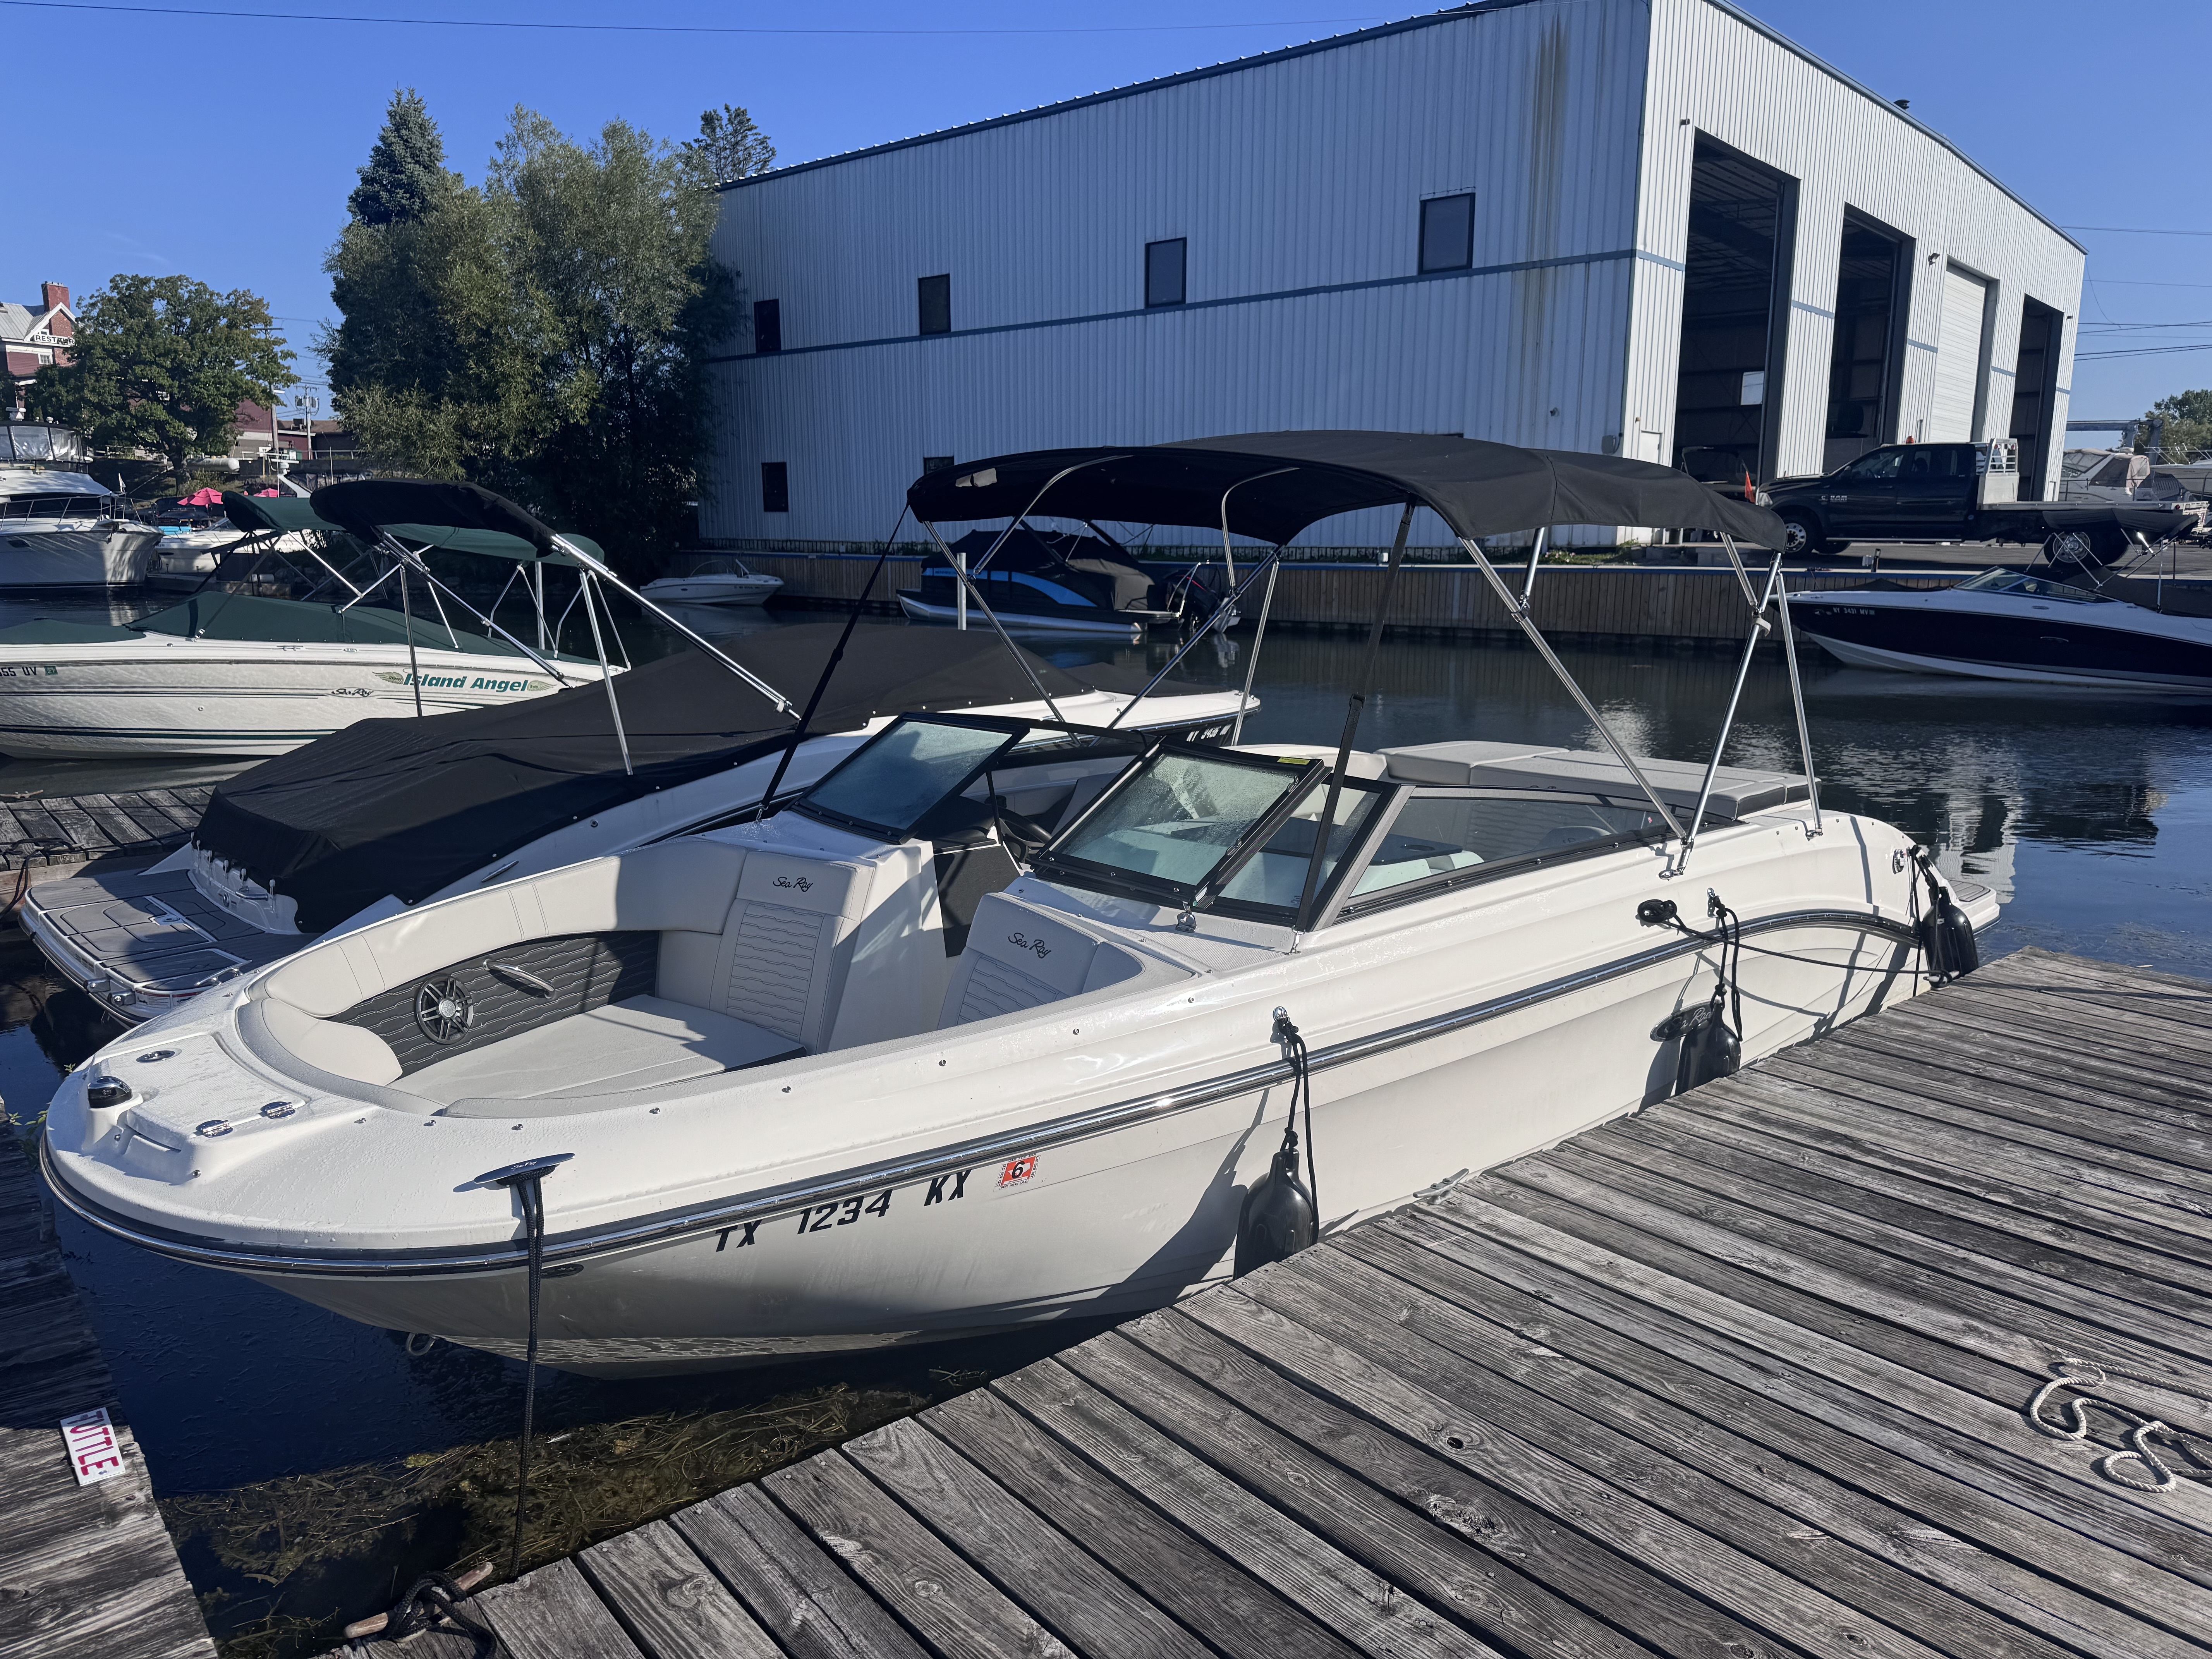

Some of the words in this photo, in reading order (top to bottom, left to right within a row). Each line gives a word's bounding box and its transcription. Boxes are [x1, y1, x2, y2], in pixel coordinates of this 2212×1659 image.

[36, 335, 74, 344] RESTR
[0, 667, 16, 676] 55
[22, 666, 37, 675] UV
[403, 674, 467, 688] Island
[471, 677, 528, 692] Angel
[352, 688, 374, 697] Ray
[773, 876, 793, 888] Sea
[793, 877, 813, 892] Ray
[1008, 933, 1029, 948] Sea
[1029, 939, 1051, 959] Ray
[1012, 1161, 1025, 1179] 6
[716, 1219, 763, 1252] TX
[797, 1189, 893, 1234] 1234
[924, 1169, 972, 1206] KX
[67, 1410, 119, 1476] TUTTLE
